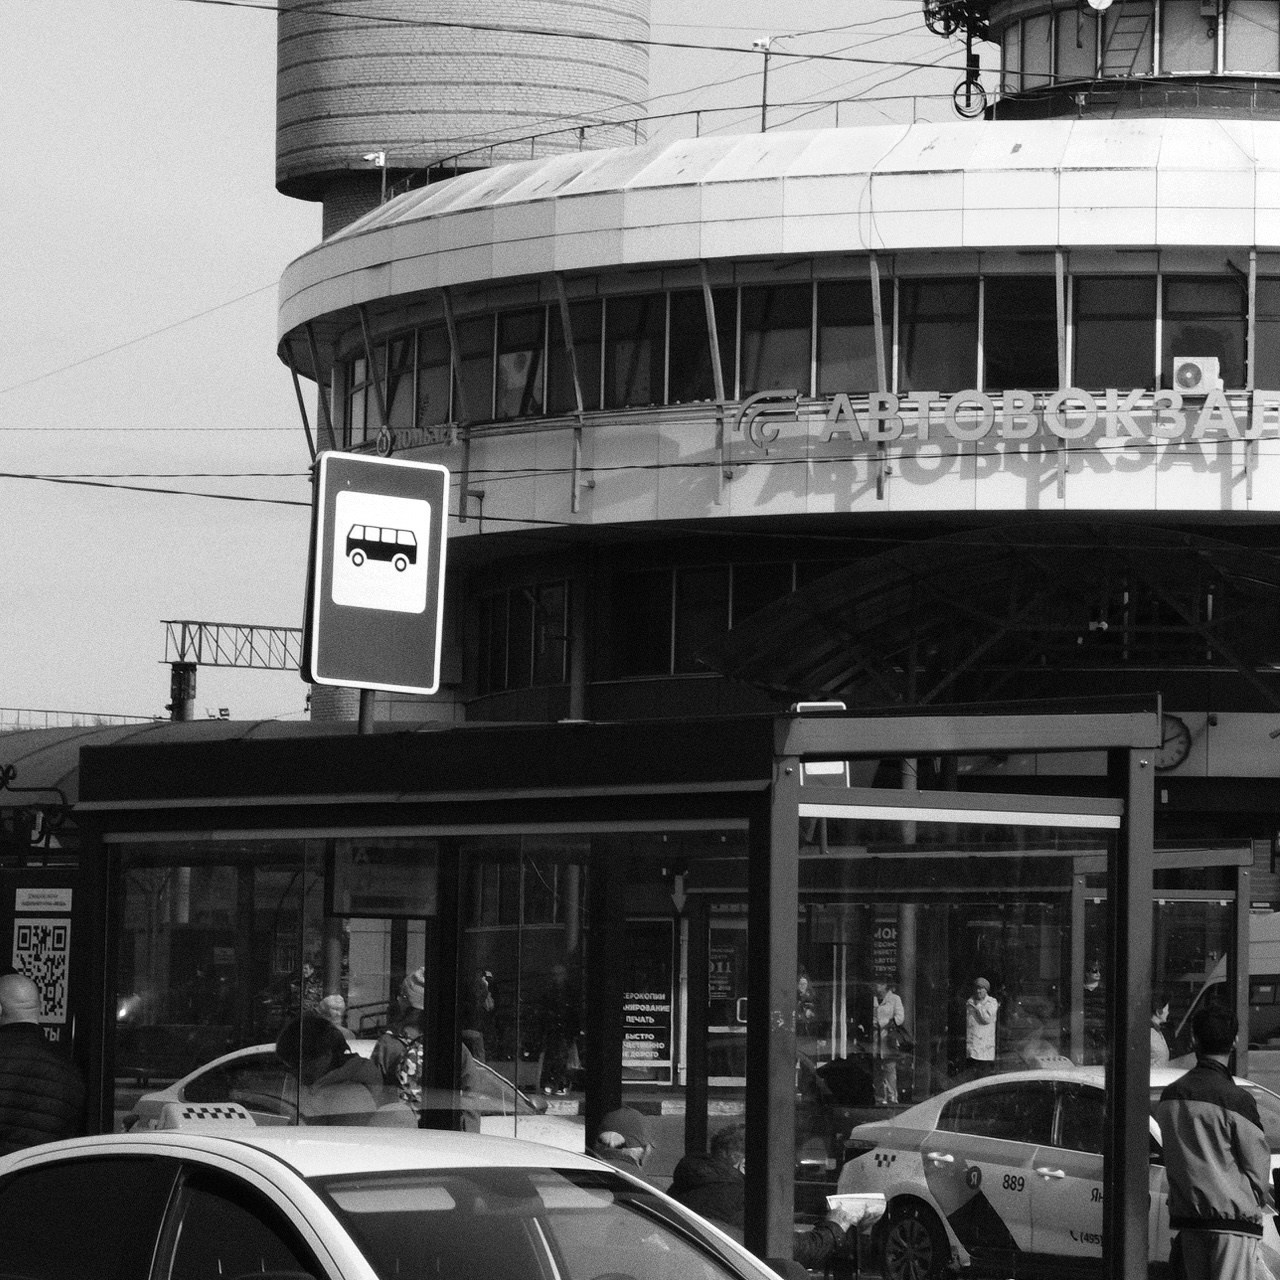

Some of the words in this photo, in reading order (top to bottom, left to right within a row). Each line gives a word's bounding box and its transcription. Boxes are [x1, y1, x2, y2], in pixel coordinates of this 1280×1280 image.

[625, 1015, 655, 1024] ПЕЧАТЬ
[624, 1032, 655, 1041] БЫСТРО
[1002, 1174, 1026, 1192] 889
